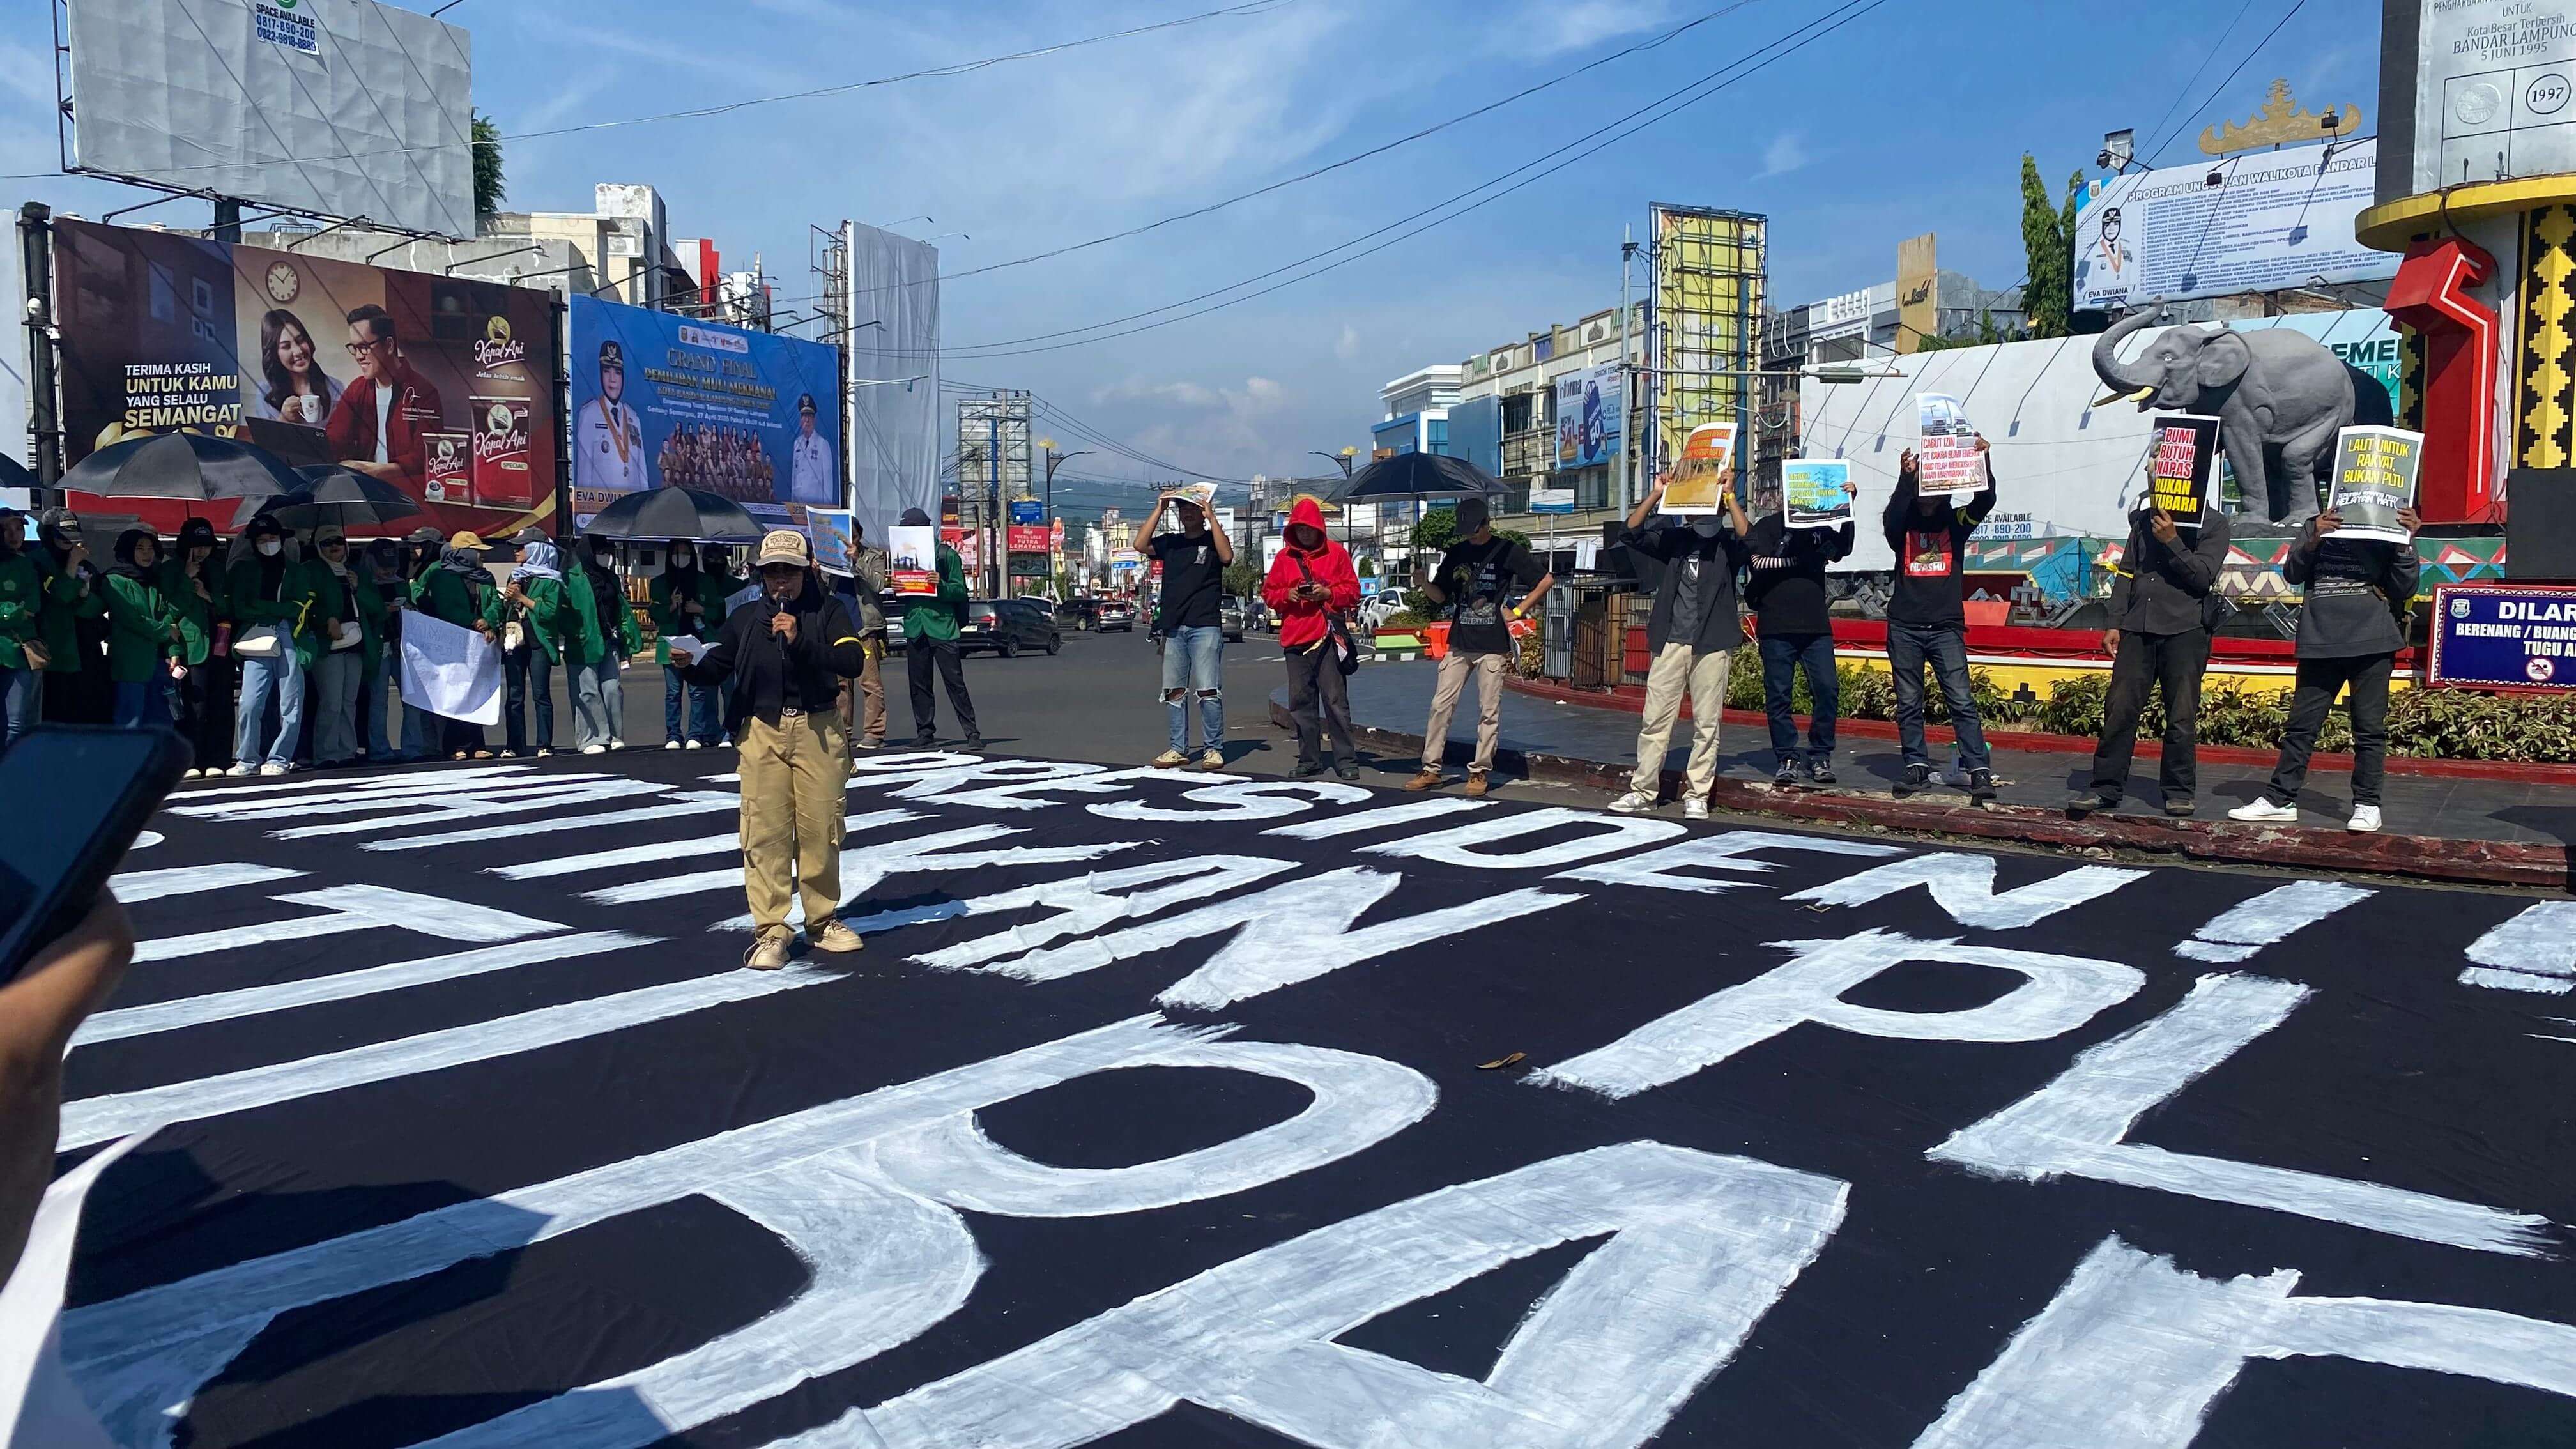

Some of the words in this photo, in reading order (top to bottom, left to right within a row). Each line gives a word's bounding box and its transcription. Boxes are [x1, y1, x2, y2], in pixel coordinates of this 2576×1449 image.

[256, 3, 278, 17] SPACE
[280, 10, 315, 28] AVAILABLE
[2502, 2, 2533, 17] UNTUK
[257, 15, 316, 40] 0817-890-200
[2467, 26, 2488, 38] Kota
[2491, 22, 2517, 34] Besar
[2520, 12, 2566, 29] Terbersih
[2453, 33, 2508, 54] BANDAR
[2481, 50, 2487, 61] 5
[2490, 47, 2515, 62] JUNI
[2520, 41, 2548, 56] 1995
[2532, 86, 2564, 103] 1997
[2128, 183, 2184, 203] PROGRAM
[2250, 165, 2311, 185] WALIKOTA
[2102, 287, 2128, 296] DWIANA
[475, 339, 505, 364] Kapal
[505, 340, 524, 359] Api
[125, 364, 171, 376] TERIMA
[175, 363, 210, 374] KASIH
[667, 348, 716, 372] GRAND
[723, 358, 757, 379] FINAL
[126, 377, 184, 394] UNTUK
[189, 375, 237, 391] KAMU
[126, 395, 160, 407] YANG
[163, 394, 208, 406] SELALU
[124, 403, 241, 428] SEMANGAT
[475, 432, 506, 458] Kapal
[506, 429, 528, 450] Api
[1923, 438, 1942, 448] CABUT
[1943, 437, 1955, 447] IZIN
[2165, 428, 2195, 445] BUMI
[2160, 445, 2195, 461] BUTUH
[2348, 438, 2374, 452] LAUT
[2375, 439, 2409, 457] UNTUK
[429, 457, 449, 474] Kapal
[2156, 461, 2193, 478] NAPAS
[2356, 454, 2396, 472] RAKYAT,
[2155, 478, 2191, 495] BUKAN
[2343, 470, 2379, 484] BUKAN
[2382, 471, 2404, 488] PLTU
[576, 491, 595, 501] EVA
[1995, 513, 2032, 523] AVAILABLE
[1910, 562, 1946, 572] NDASMU
[2456, 622, 2522, 638] BERENANG
[2533, 625, 2576, 640] BUANG
[2524, 641, 2562, 656] TUGU
